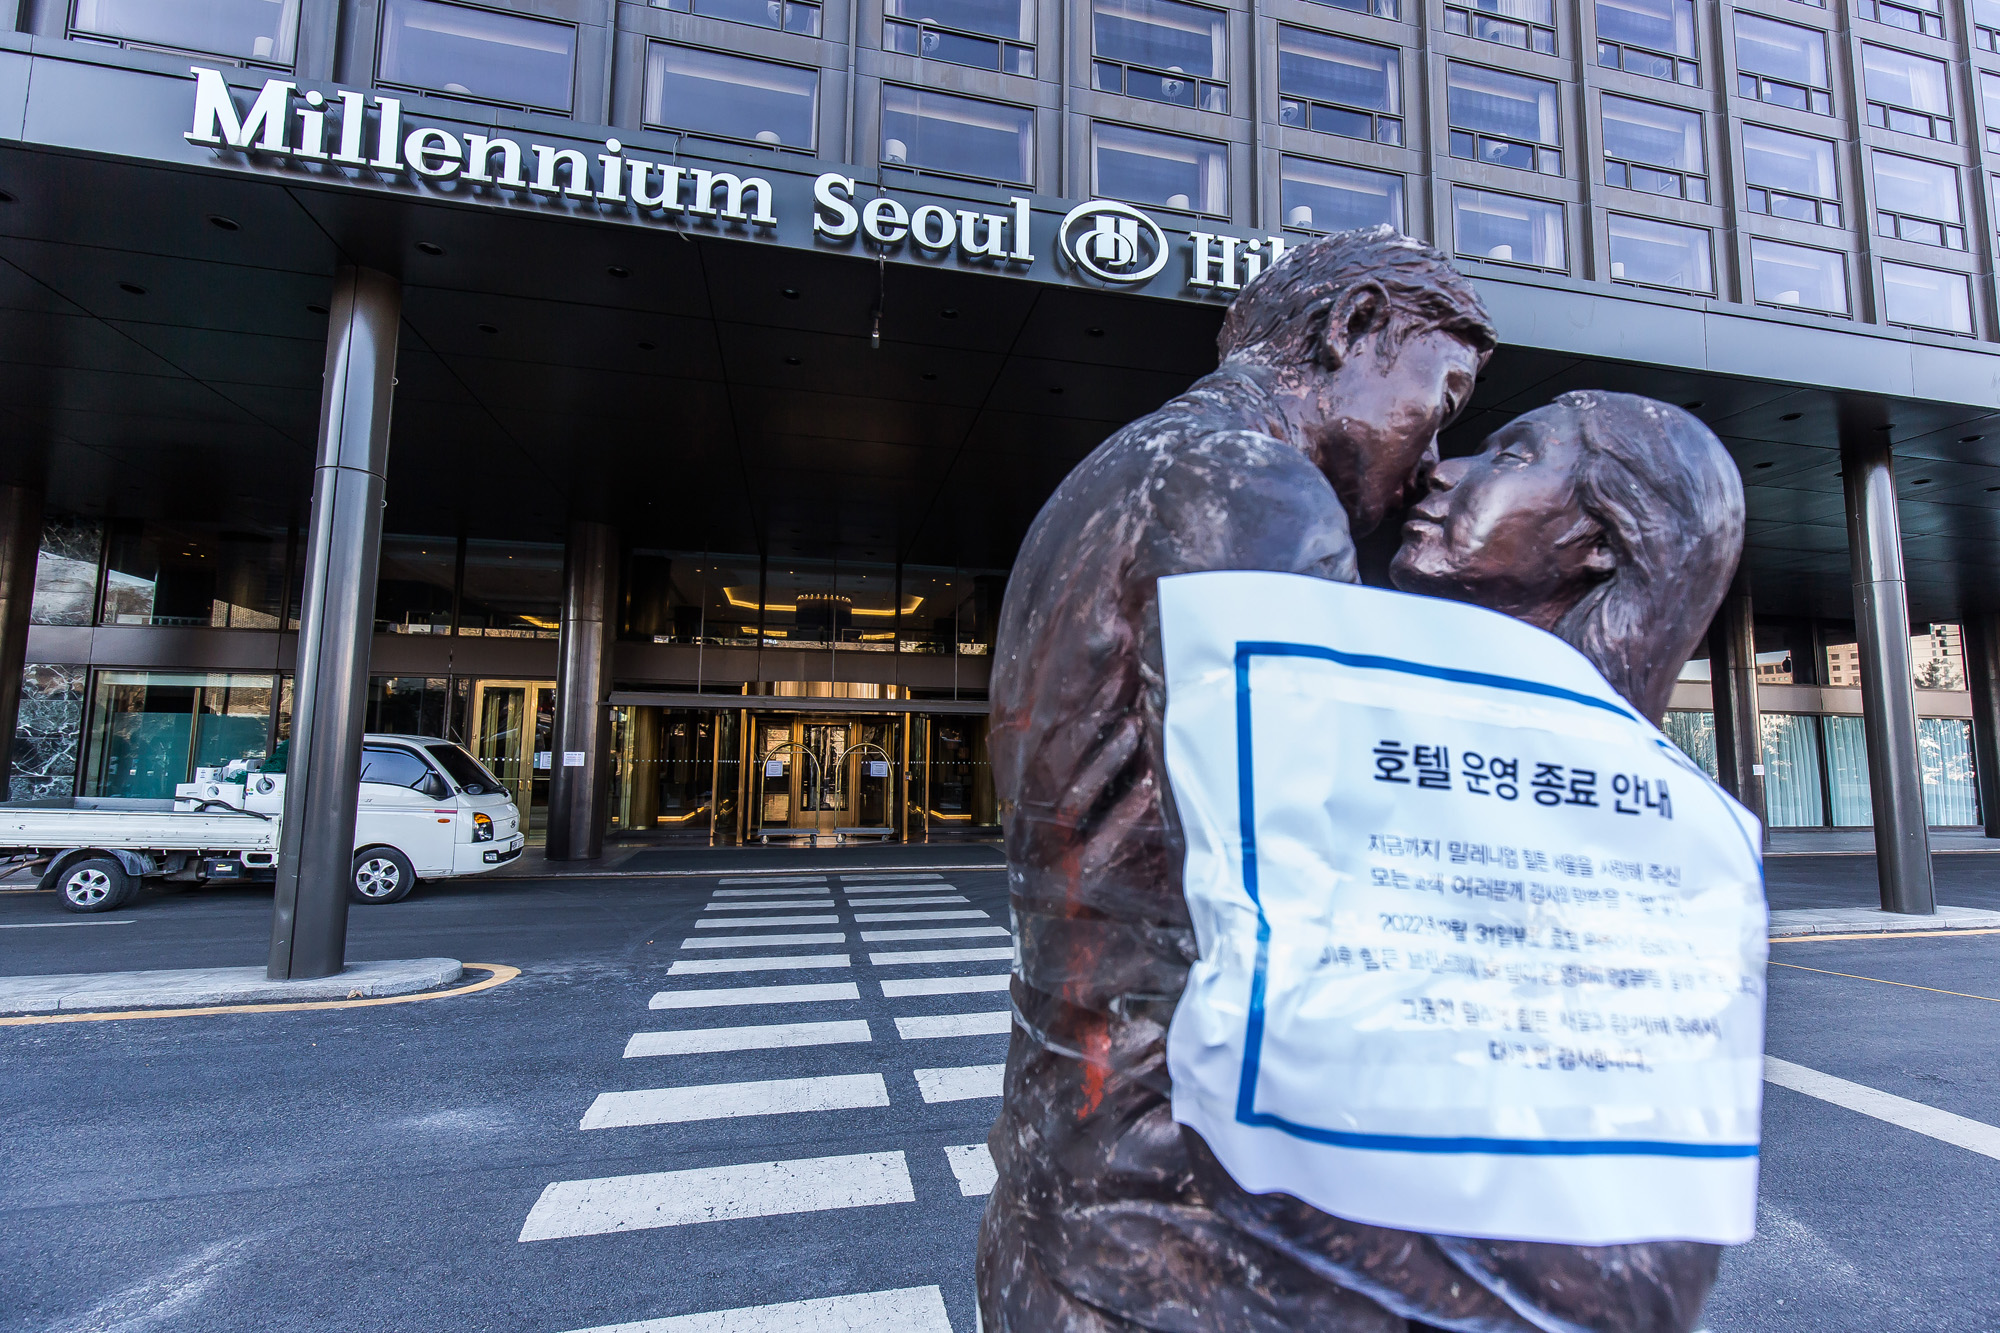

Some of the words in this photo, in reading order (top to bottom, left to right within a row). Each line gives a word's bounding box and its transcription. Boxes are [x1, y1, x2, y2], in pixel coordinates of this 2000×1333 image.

[184, 66, 778, 228] Millennium
[813, 172, 1035, 264] Seoul
[1373, 740, 1452, 791] 호텔
[1462, 750, 1520, 801] 운영
[1530, 761, 1600, 808] 종료
[1612, 772, 1674, 821] 안내
[1368, 833, 1440, 862] 지금까지
